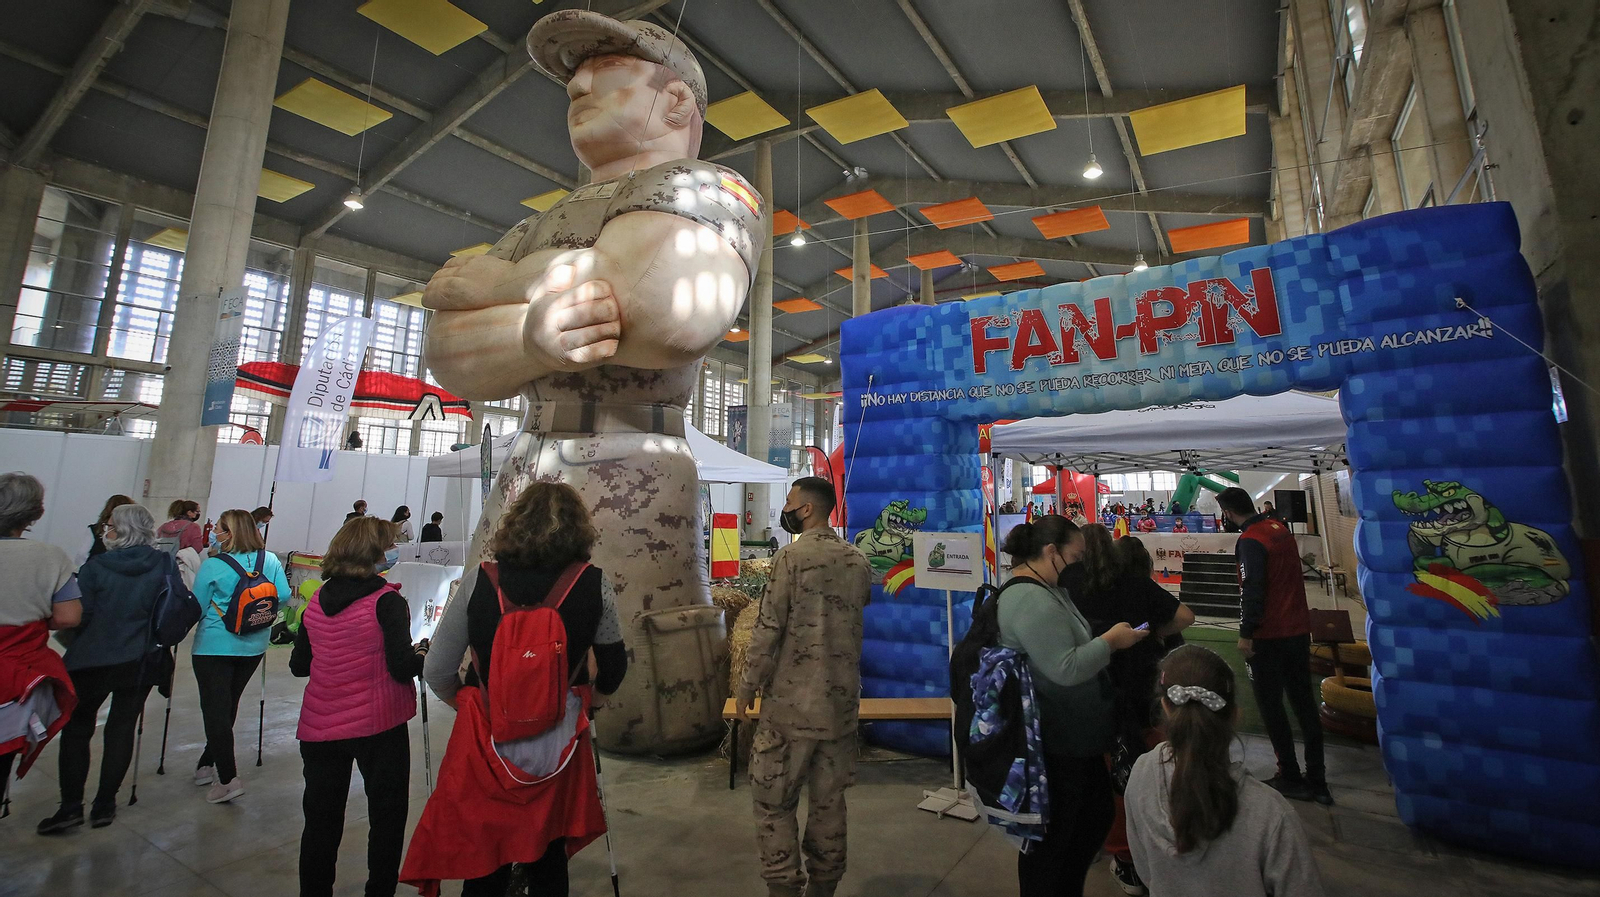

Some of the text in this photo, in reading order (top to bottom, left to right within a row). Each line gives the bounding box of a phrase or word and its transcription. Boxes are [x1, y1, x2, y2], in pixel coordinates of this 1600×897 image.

[887, 392, 907, 404] HAY
[910, 386, 965, 402] DISTANCIA
[967, 385, 992, 398] QUE
[995, 383, 1015, 396] NO
[1016, 380, 1036, 394] SE
[1039, 375, 1080, 392] PUEDA
[1083, 368, 1160, 389] RECORRER
[1159, 365, 1175, 380] NI
[1178, 361, 1214, 377] META
[1218, 354, 1253, 373] QUE
[1257, 349, 1284, 367] NO
[1287, 345, 1313, 361] SE
[1317, 337, 1375, 357] PUEDA
[1380, 316, 1494, 350] ALCANZAR!!
[970, 266, 1283, 375] FAN-PIN
[307, 331, 344, 408] Diputación
[331, 350, 359, 412] de Cádiz
